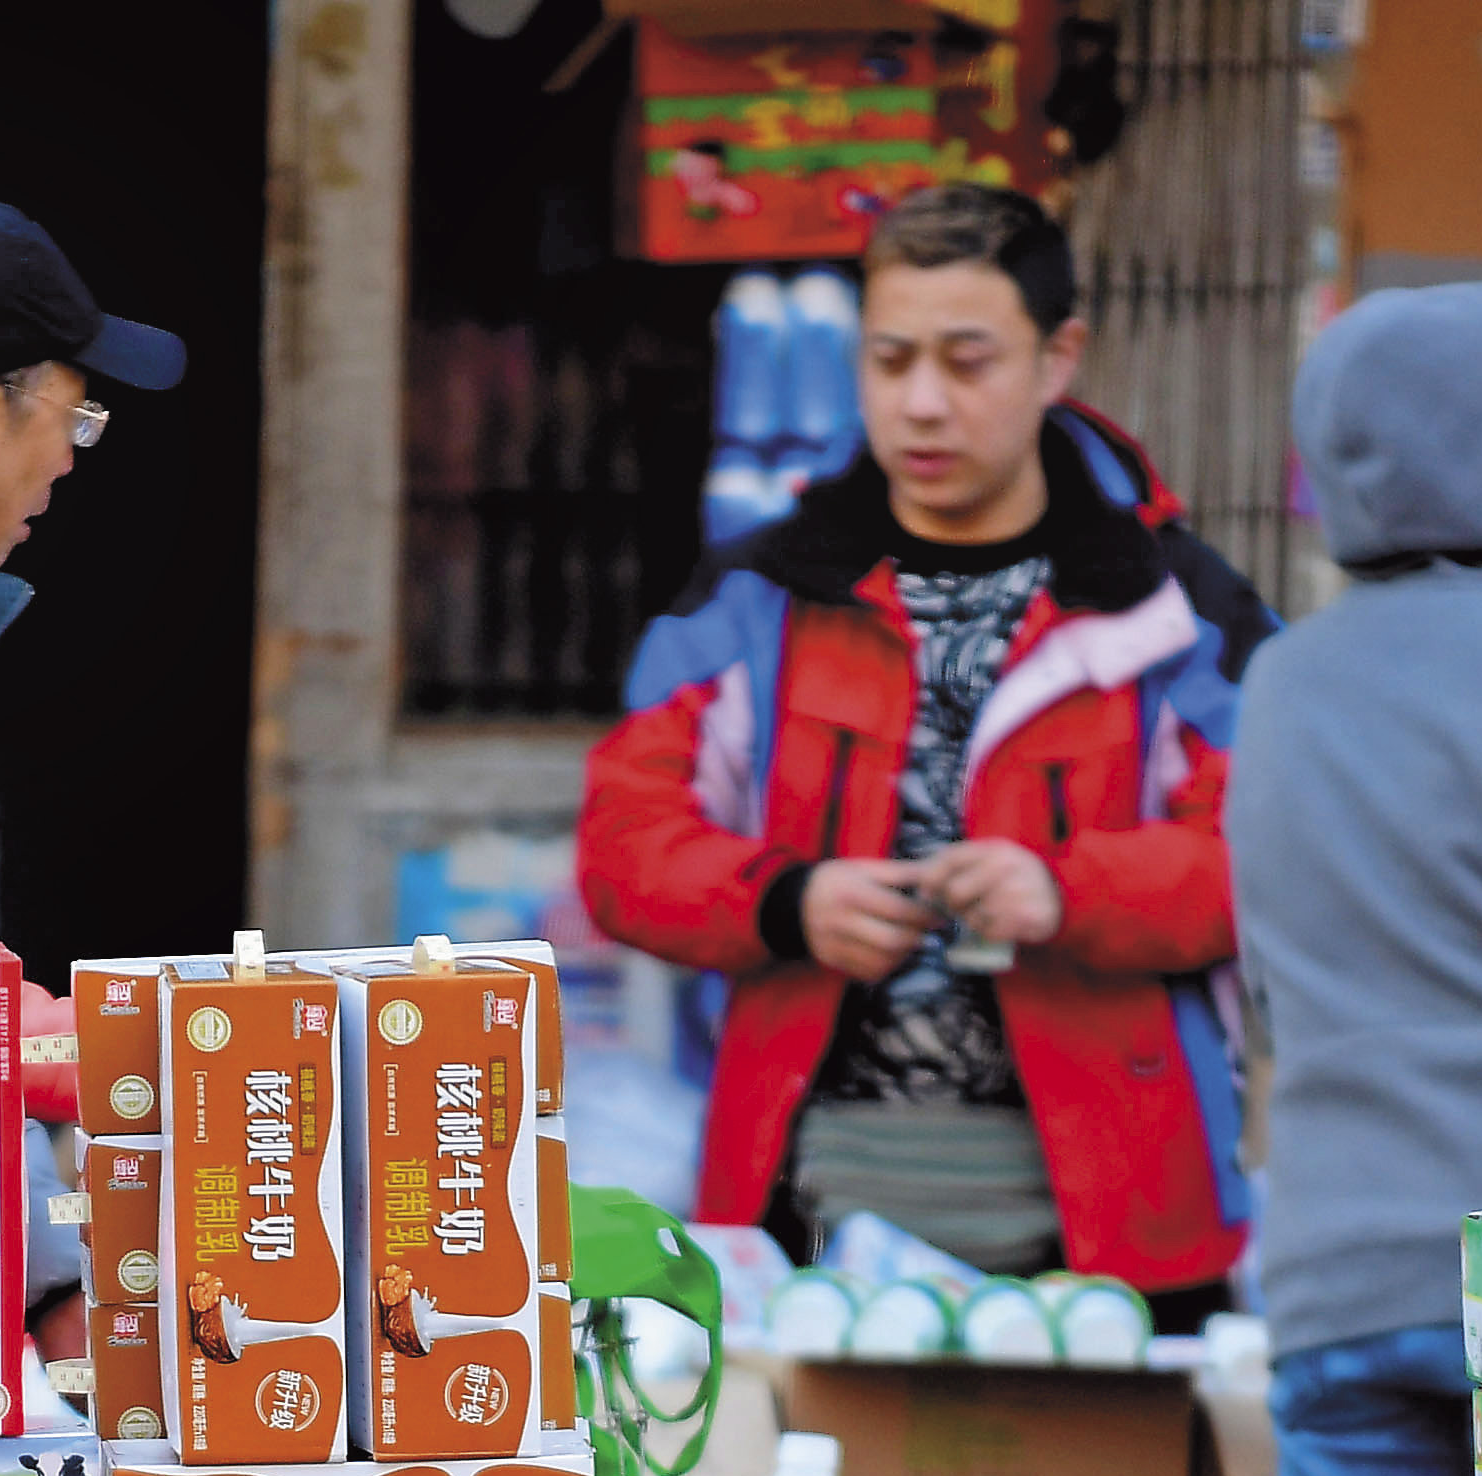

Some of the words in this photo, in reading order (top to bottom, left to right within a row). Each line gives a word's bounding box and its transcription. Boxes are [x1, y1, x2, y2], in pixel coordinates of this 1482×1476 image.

[244, 1069, 296, 1261] 核桃牛奶
[383, 1157, 431, 1256] 调制乳
[432, 1063, 486, 1256] 核桃牛奶
[193, 1164, 241, 1262] 调制乳
[275, 1368, 304, 1430] 新升级
